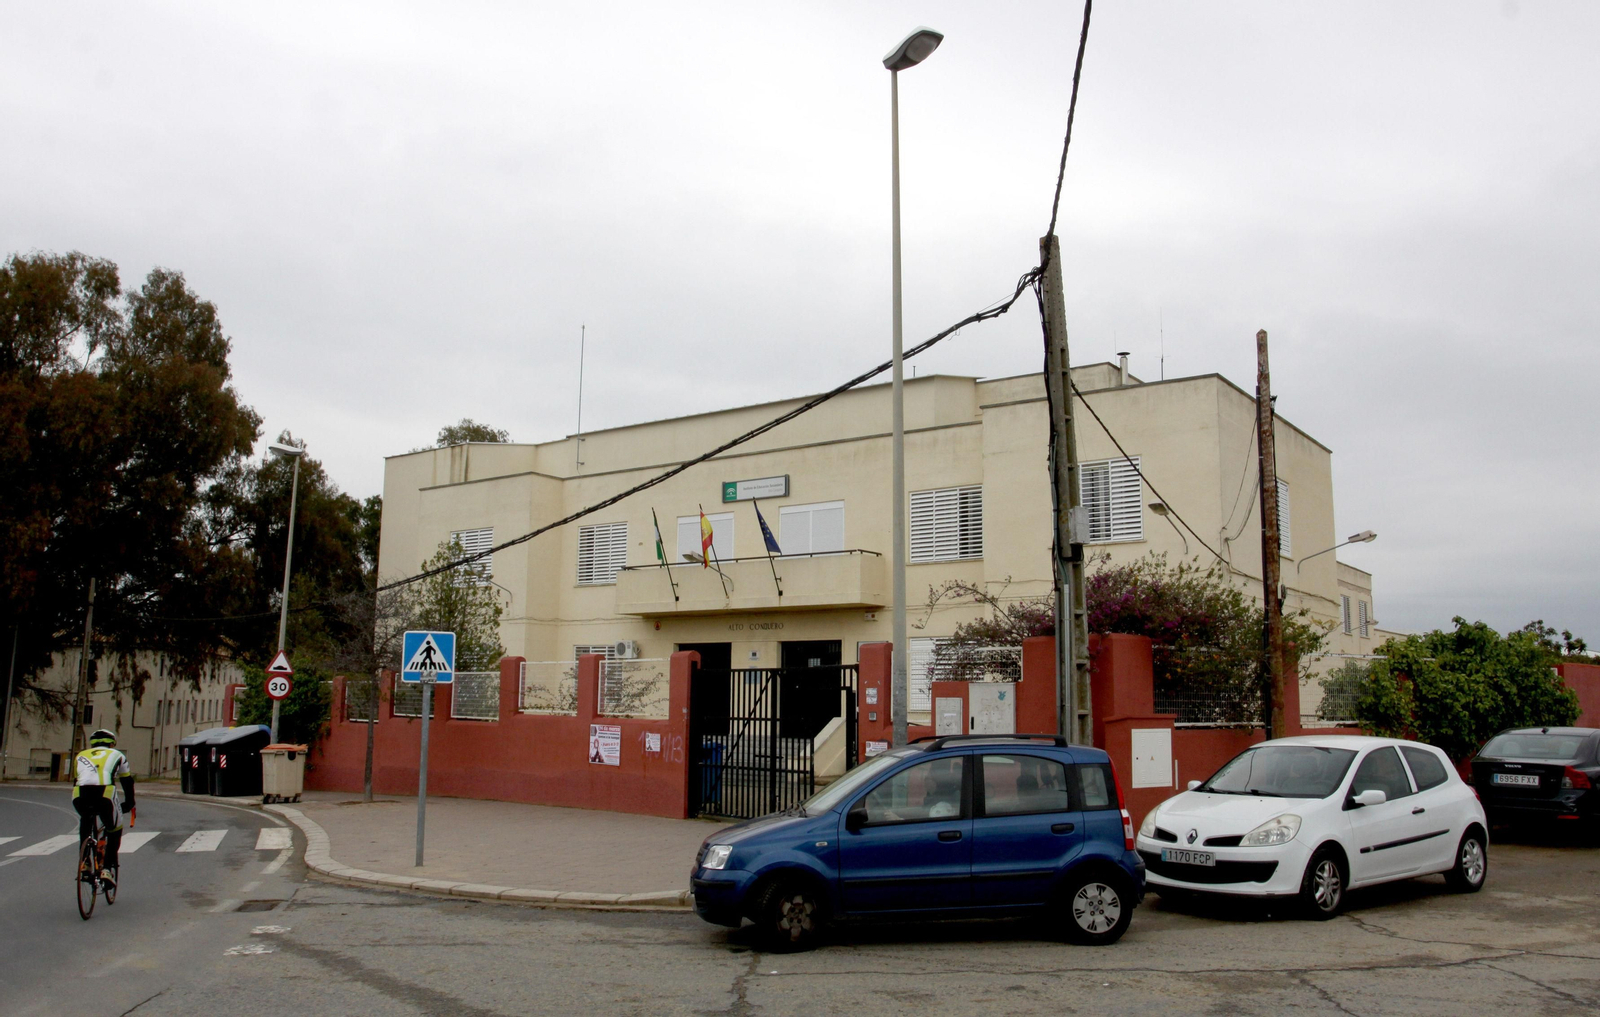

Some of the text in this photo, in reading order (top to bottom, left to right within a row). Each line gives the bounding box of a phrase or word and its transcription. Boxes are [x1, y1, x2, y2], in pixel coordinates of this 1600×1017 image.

[728, 623, 744, 631] ALTO
[270, 682, 287, 692] 30
[78, 756, 97, 773] SCOTT
[1499, 775, 1537, 784] 6956 FXX
[1169, 850, 1210, 864] 1170 FCP
